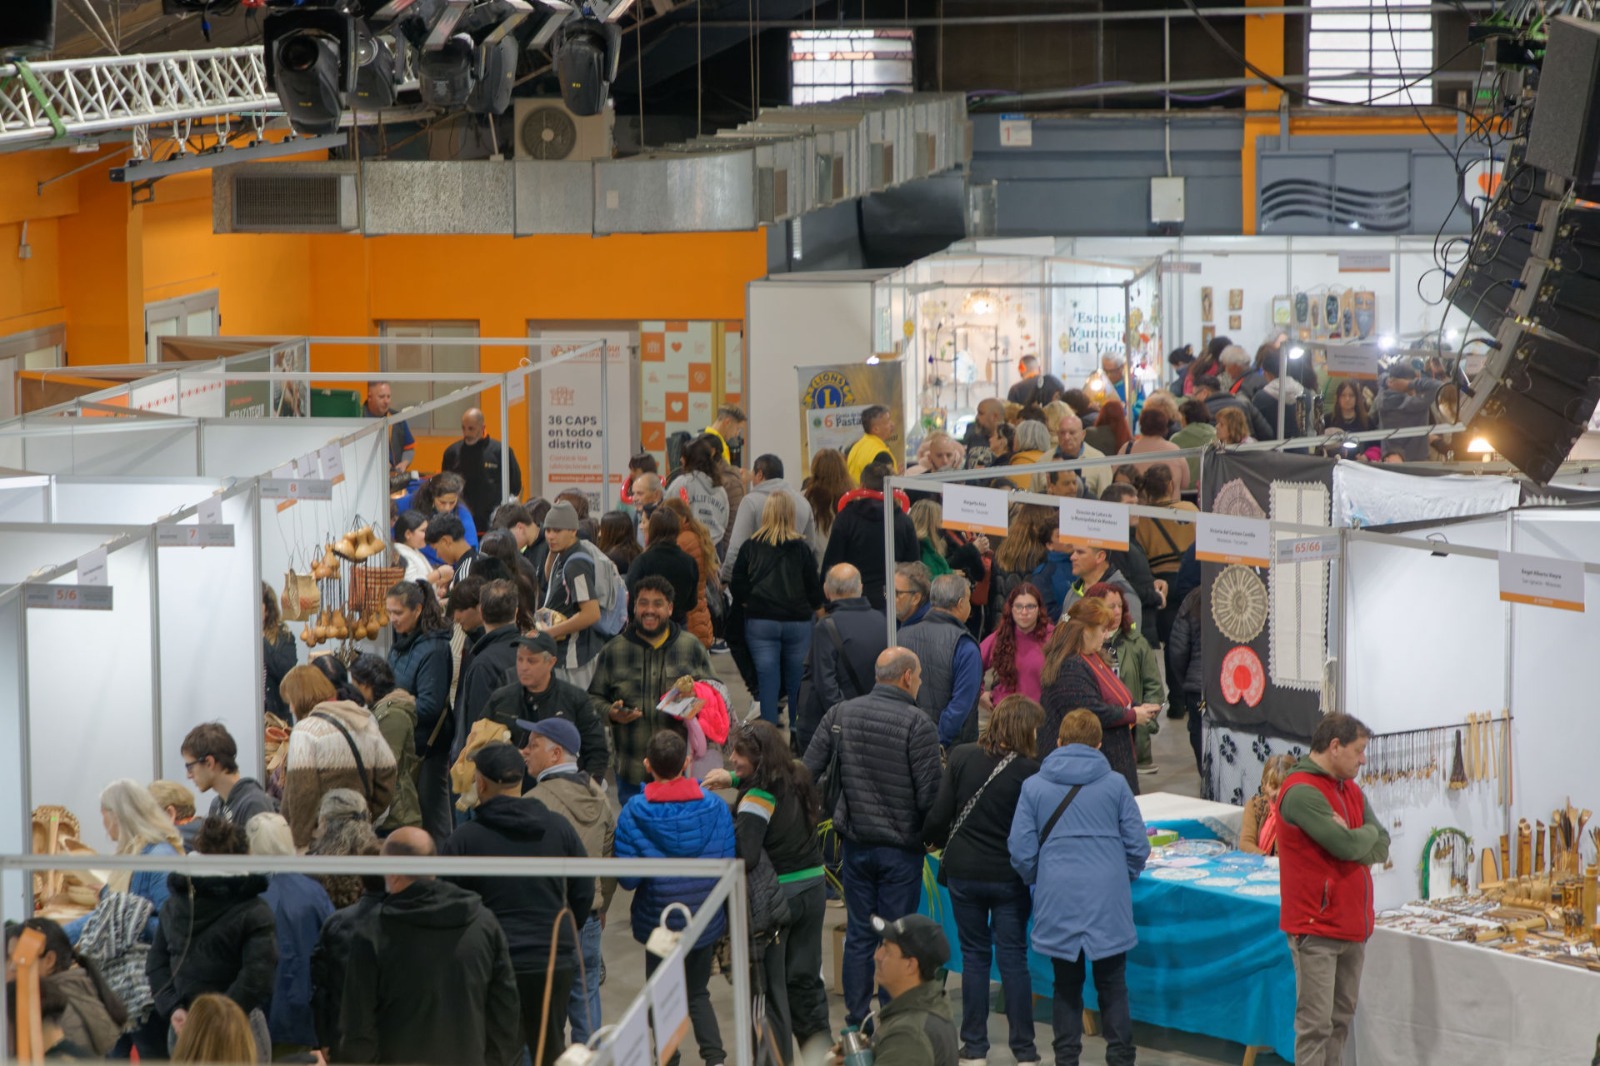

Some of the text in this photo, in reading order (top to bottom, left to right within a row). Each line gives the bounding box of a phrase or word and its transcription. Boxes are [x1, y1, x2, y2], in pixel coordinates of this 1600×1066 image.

[1069, 327, 1123, 342] Municip
[1069, 342, 1125, 353] del Vidr
[814, 373, 844, 386] LIONS
[823, 389, 837, 408] L
[548, 415, 597, 425] 36 CAPS
[824, 414, 863, 428] 6 Pasta
[548, 429, 563, 437] en
[566, 428, 593, 437] todo
[548, 439, 592, 449] distrito
[290, 483, 297, 493] 8
[690, 494, 725, 514] ALIFORNIA
[189, 529, 196, 539] 7
[1295, 541, 1320, 553] 65/66
[56, 589, 77, 601] 5/6
